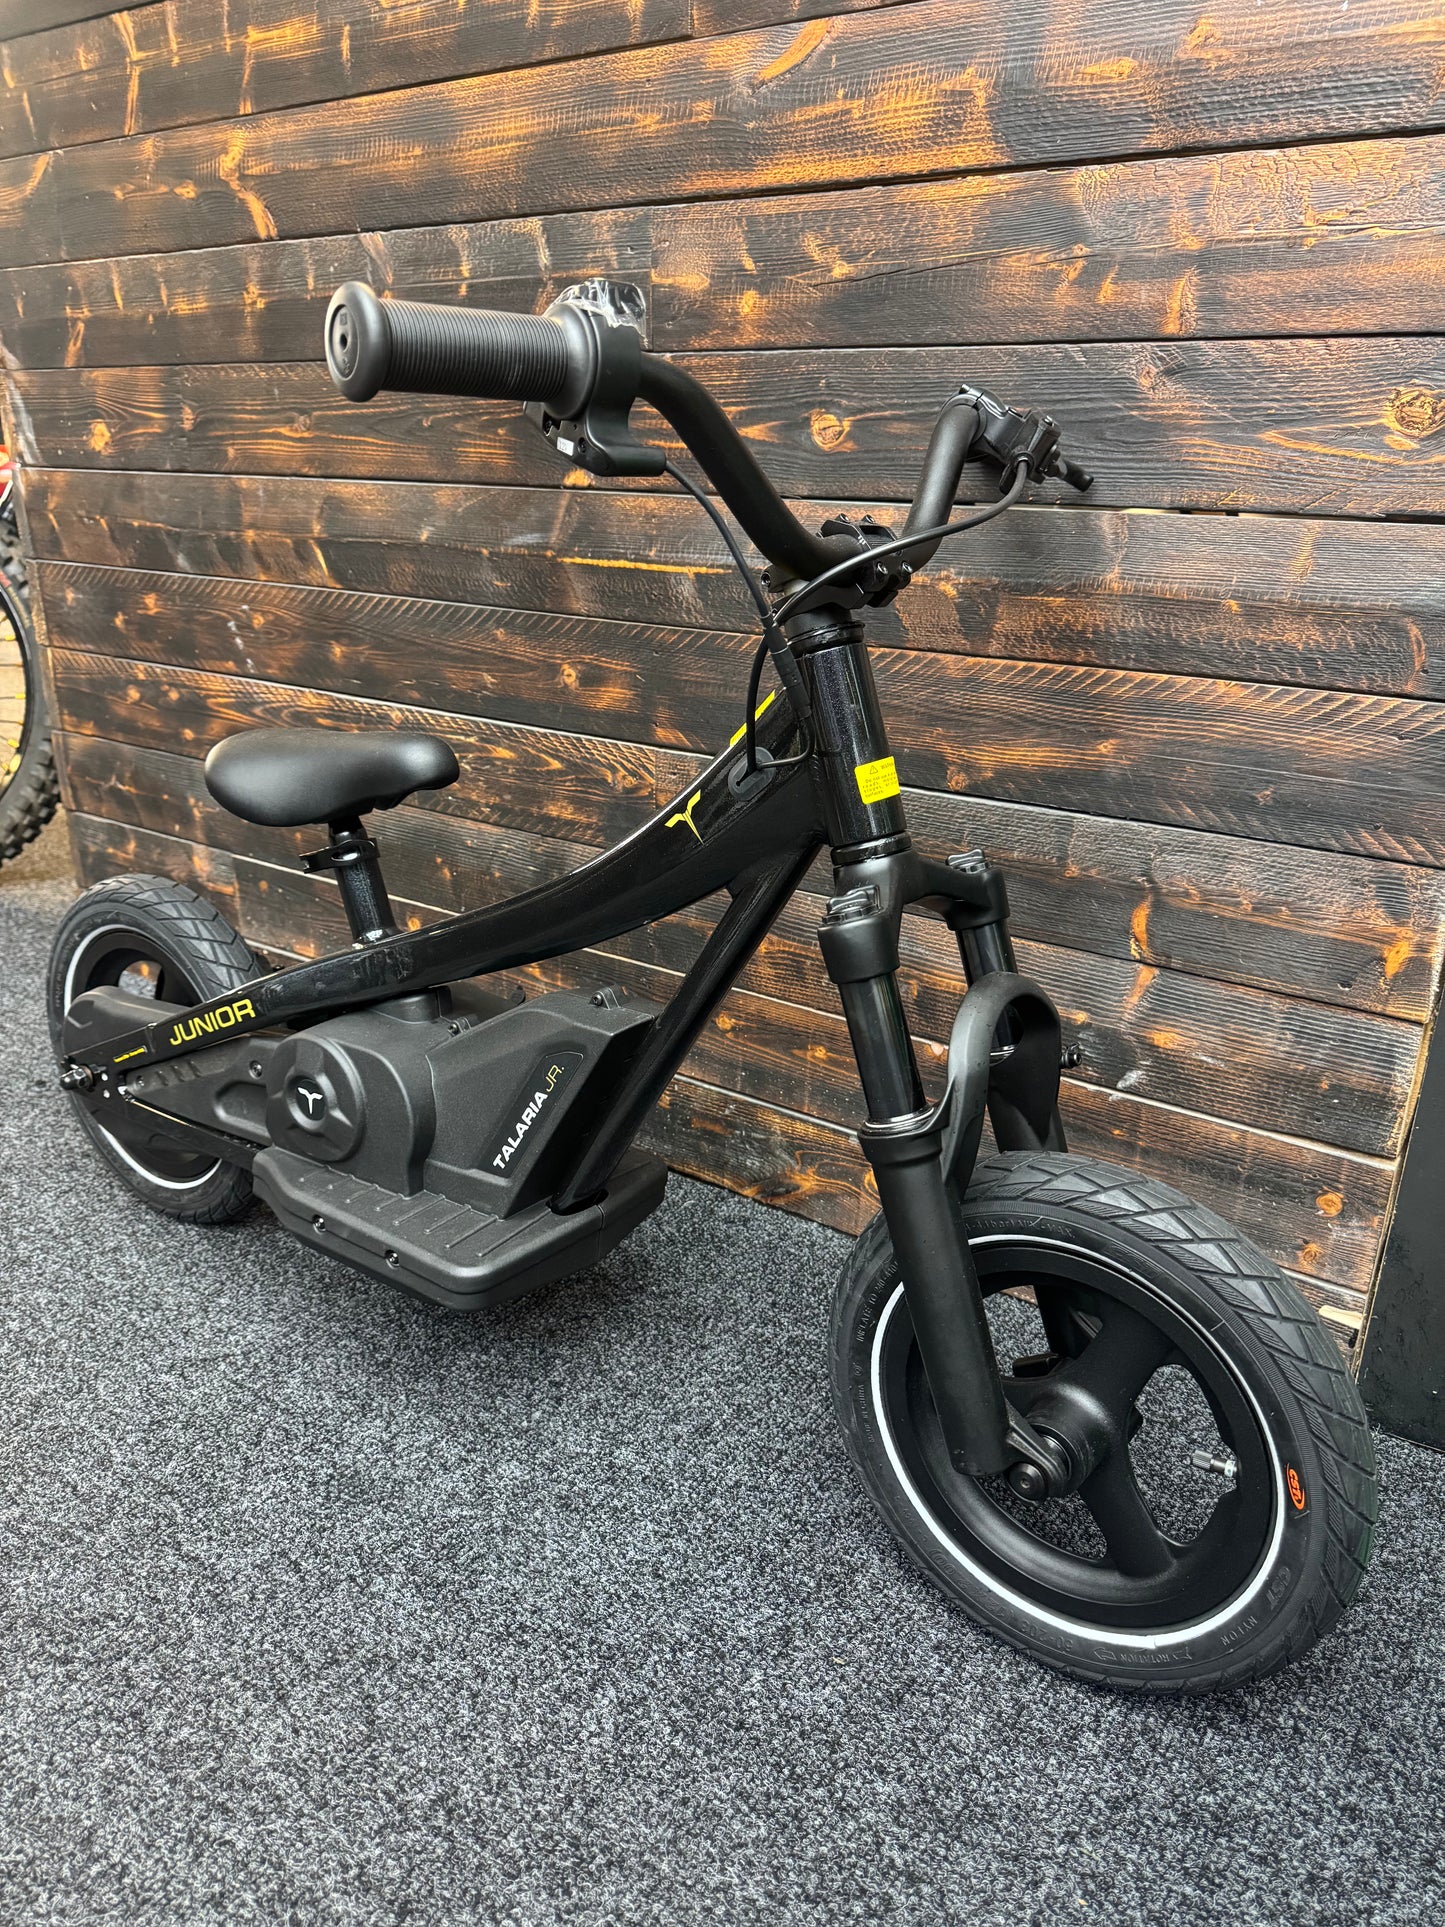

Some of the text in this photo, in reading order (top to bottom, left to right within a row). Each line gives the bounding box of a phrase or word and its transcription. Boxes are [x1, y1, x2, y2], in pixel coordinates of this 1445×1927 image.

[170, 998, 256, 1046] JUNIOR
[492, 1091, 548, 1169] TALARIA
[1219, 1615, 1258, 1646] NYLON
[1119, 1651, 1170, 1664] ROTATION
